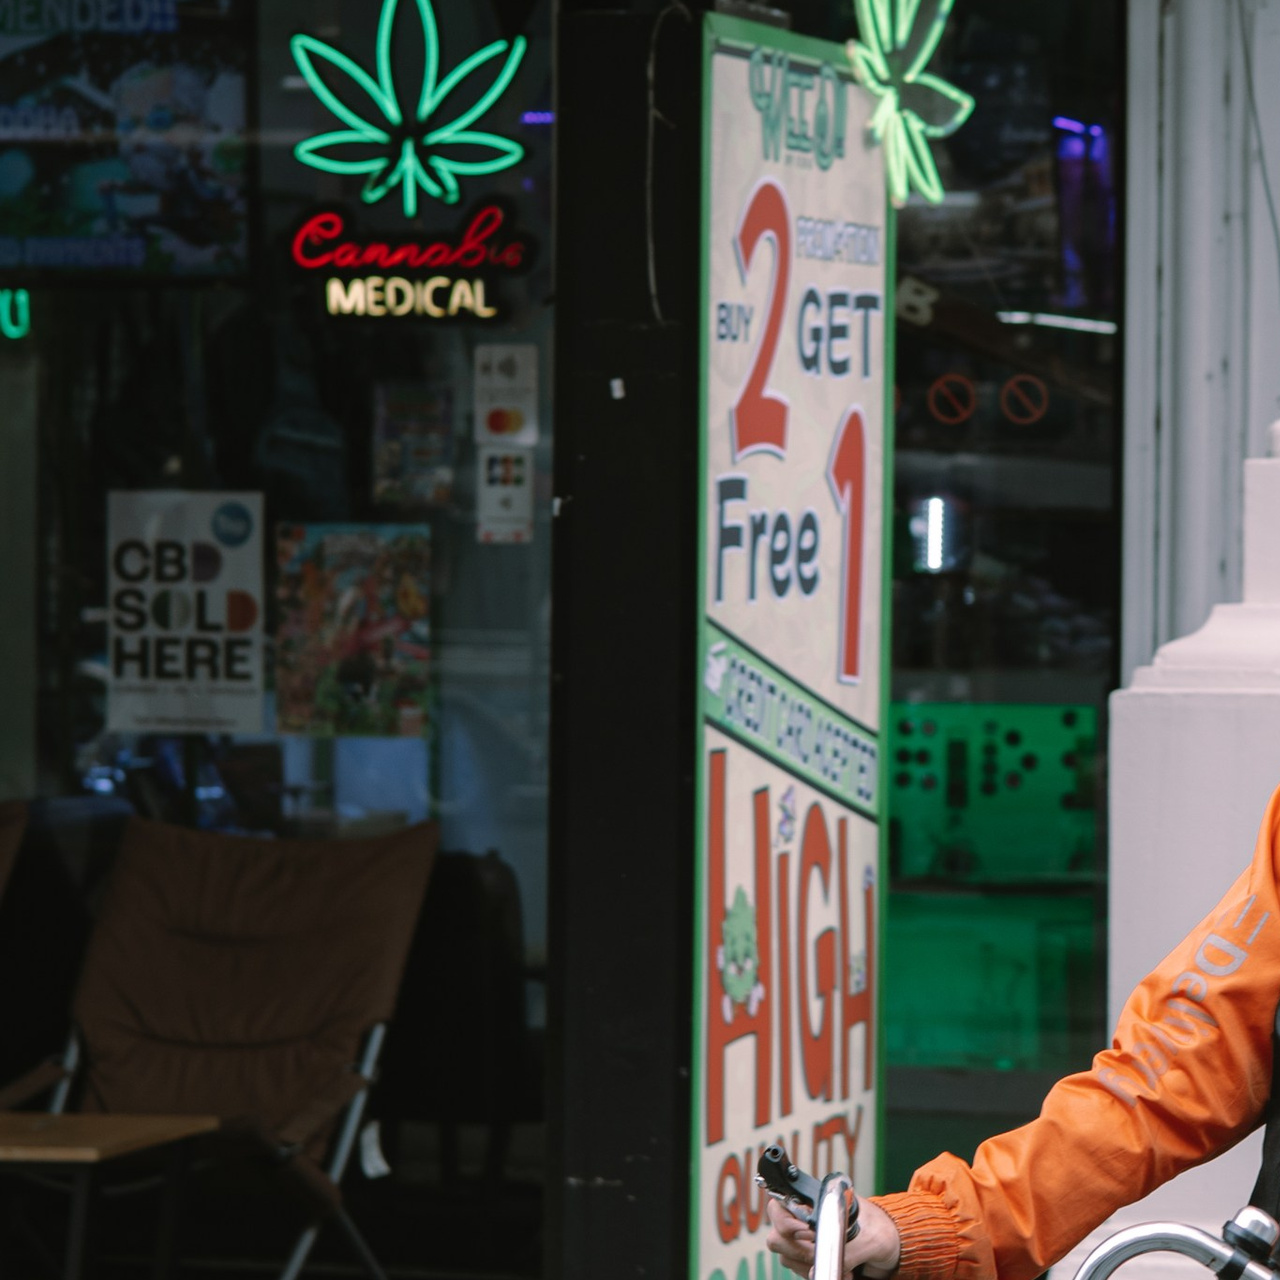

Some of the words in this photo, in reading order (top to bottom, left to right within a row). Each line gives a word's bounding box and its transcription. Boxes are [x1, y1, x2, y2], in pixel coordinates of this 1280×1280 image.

[291, 205, 526, 269] Cannabis
[326, 275, 498, 319] MEDICAL
[716, 302, 755, 347] BUY
[733, 174, 793, 464] 2
[797, 288, 882, 381] GET
[112, 538, 223, 584] CBD
[713, 470, 821, 607] Free
[827, 404, 869, 686] 1
[113, 588, 259, 632] SOLD
[112, 637, 253, 679] HERE
[1098, 932, 1249, 1109] Delivery
[716, 1104, 864, 1245] QUITY
